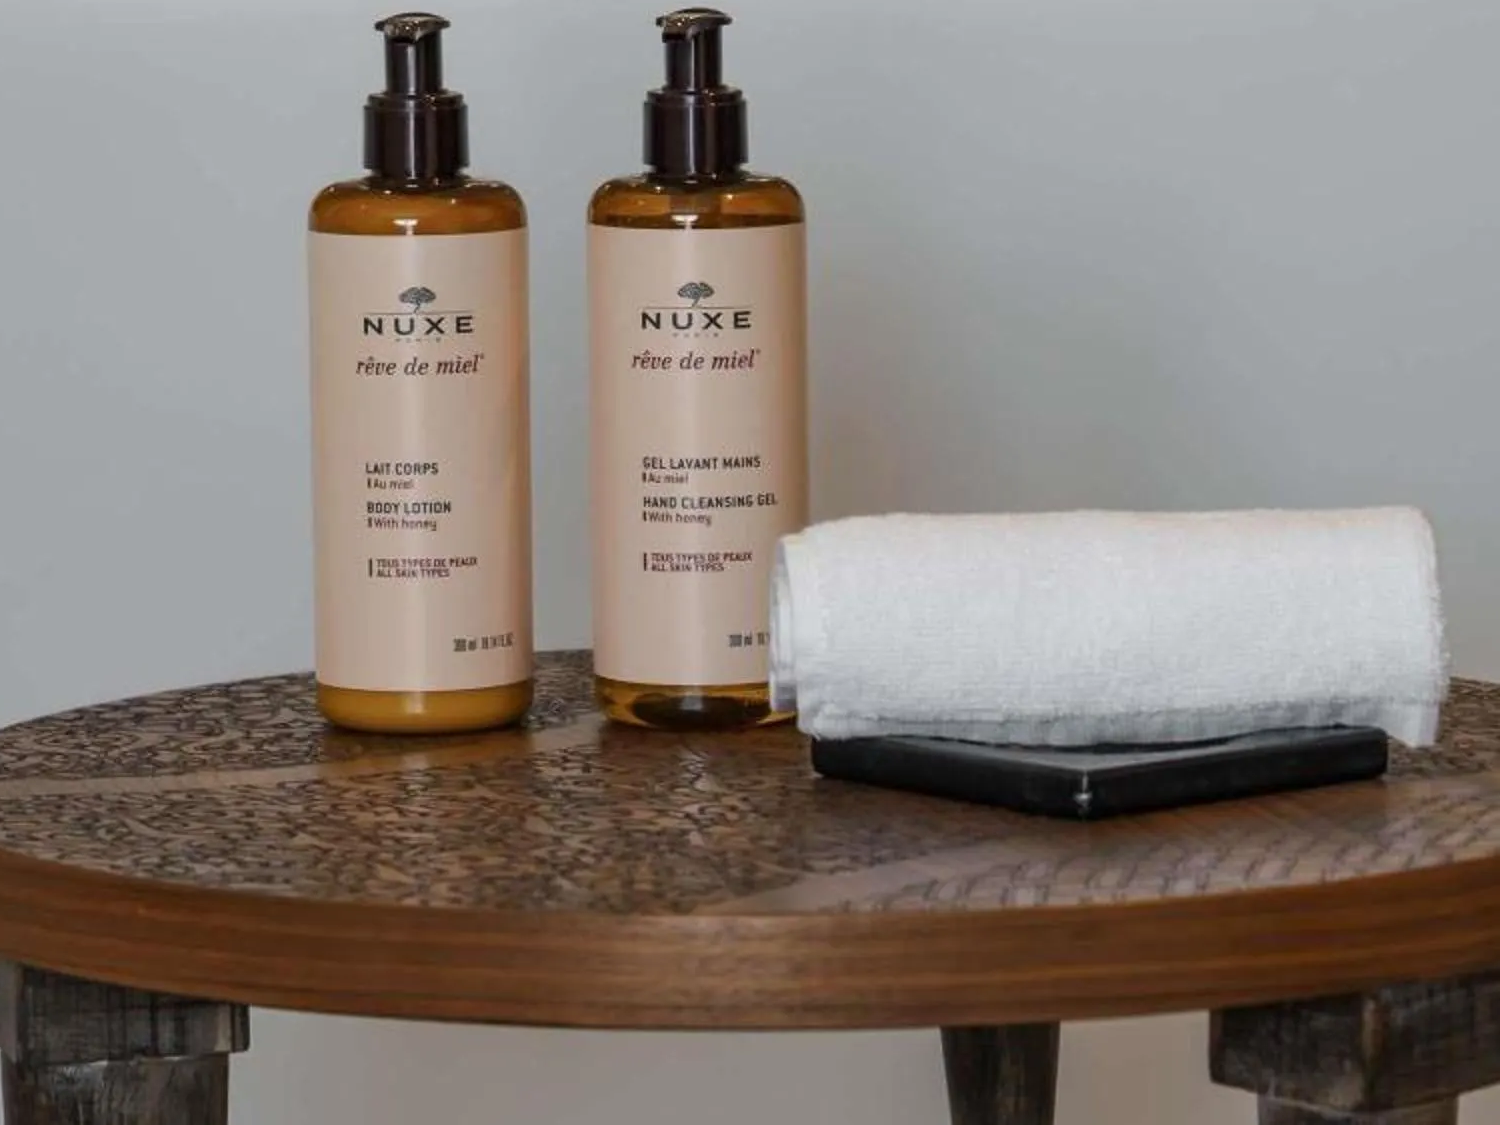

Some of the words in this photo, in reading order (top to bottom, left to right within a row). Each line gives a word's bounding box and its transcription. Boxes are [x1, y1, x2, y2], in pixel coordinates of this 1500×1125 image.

[363, 315, 473, 335] NUXE
[641, 311, 752, 330] NUXE
[356, 357, 396, 375] rêve
[404, 356, 429, 375] de
[632, 350, 672, 369] rêve
[680, 351, 705, 369] de
[365, 463, 391, 474] LAIT
[395, 463, 439, 475] CORPS
[642, 457, 666, 469] GEL
[670, 458, 718, 470] LAVANT
[722, 456, 761, 468] MAINS
[367, 502, 400, 514] BODY
[404, 502, 452, 514] LOTION
[643, 497, 677, 508] HAND
[681, 496, 753, 508] CLEANSING
[757, 493, 777, 506] GEL
[374, 517, 398, 528] With
[401, 518, 437, 531] honey
